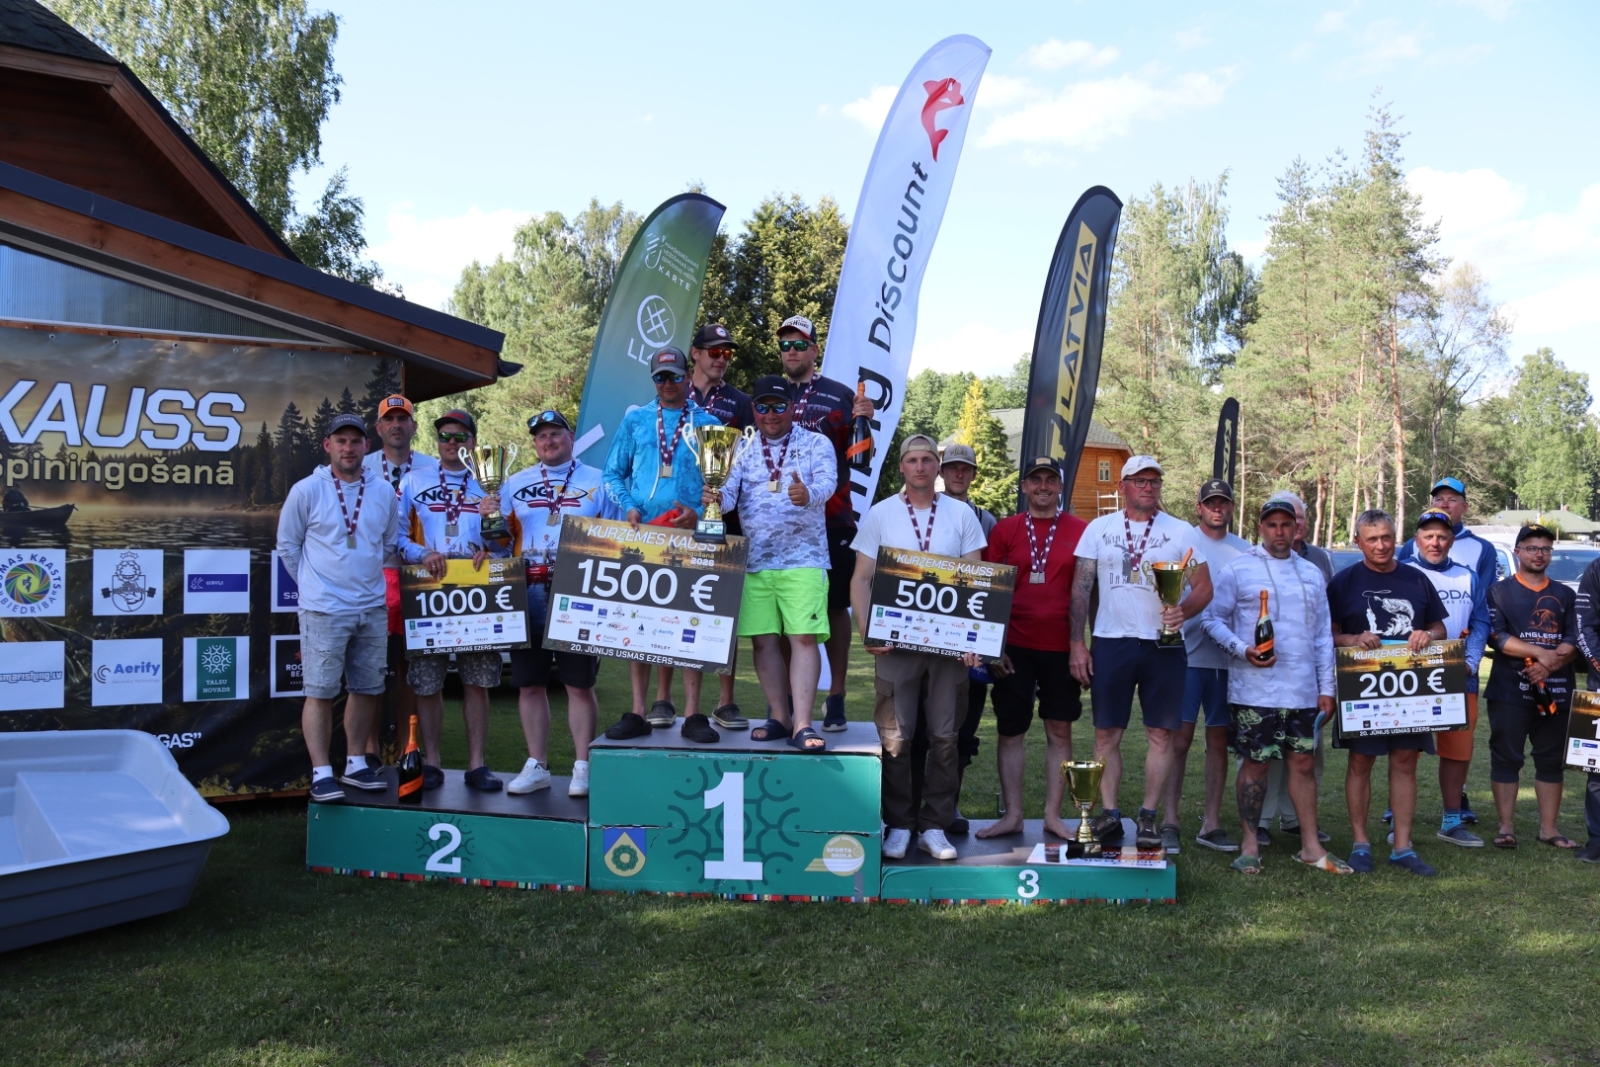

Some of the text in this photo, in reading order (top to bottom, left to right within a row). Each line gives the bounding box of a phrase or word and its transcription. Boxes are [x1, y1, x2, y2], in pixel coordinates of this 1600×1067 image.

[868, 161, 930, 354] Discount
[658, 265, 691, 291] KARTE
[1060, 242, 1093, 411] LATVIA
[587, 524, 665, 546] KURZEMES
[896, 553, 994, 577] KURZEMES KAUSS
[577, 558, 720, 612] 1500 €
[895, 580, 989, 619] 500 €
[415, 585, 514, 617] 1000 €
[113, 661, 160, 677] Aerify
[570, 643, 583, 653] 20.
[585, 644, 614, 657] JŪNIJS
[616, 648, 645, 661] USMAS
[646, 653, 673, 665] EZERS
[1353, 647, 1408, 661] KURZEMES
[1359, 668, 1446, 698] 200 €
[704, 772, 763, 880] 1
[426, 823, 462, 873] 2
[1017, 868, 1041, 899] 3
